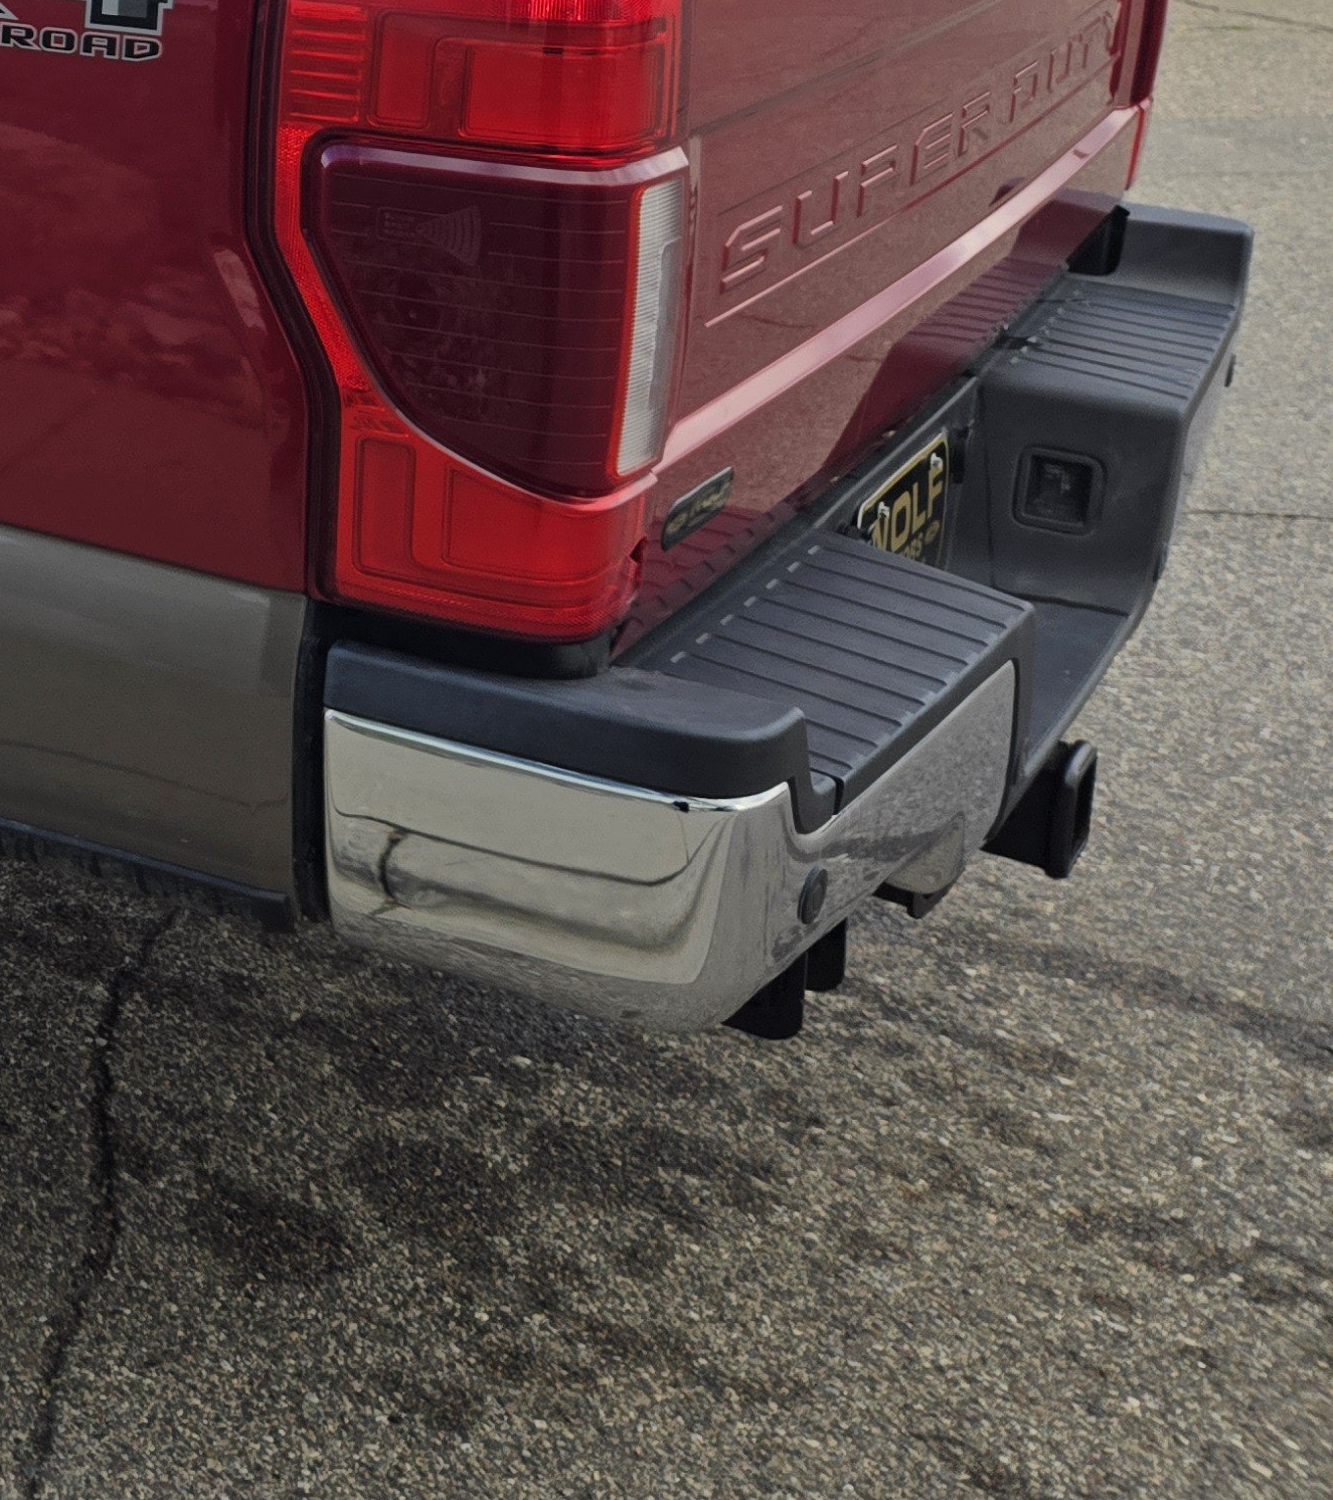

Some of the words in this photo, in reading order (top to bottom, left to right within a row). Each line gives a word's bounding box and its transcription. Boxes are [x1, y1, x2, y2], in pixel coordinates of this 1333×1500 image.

[0, 21, 163, 62] ROAD
[720, 90, 992, 296] SUPER
[1008, 9, 1116, 123] DUTY
